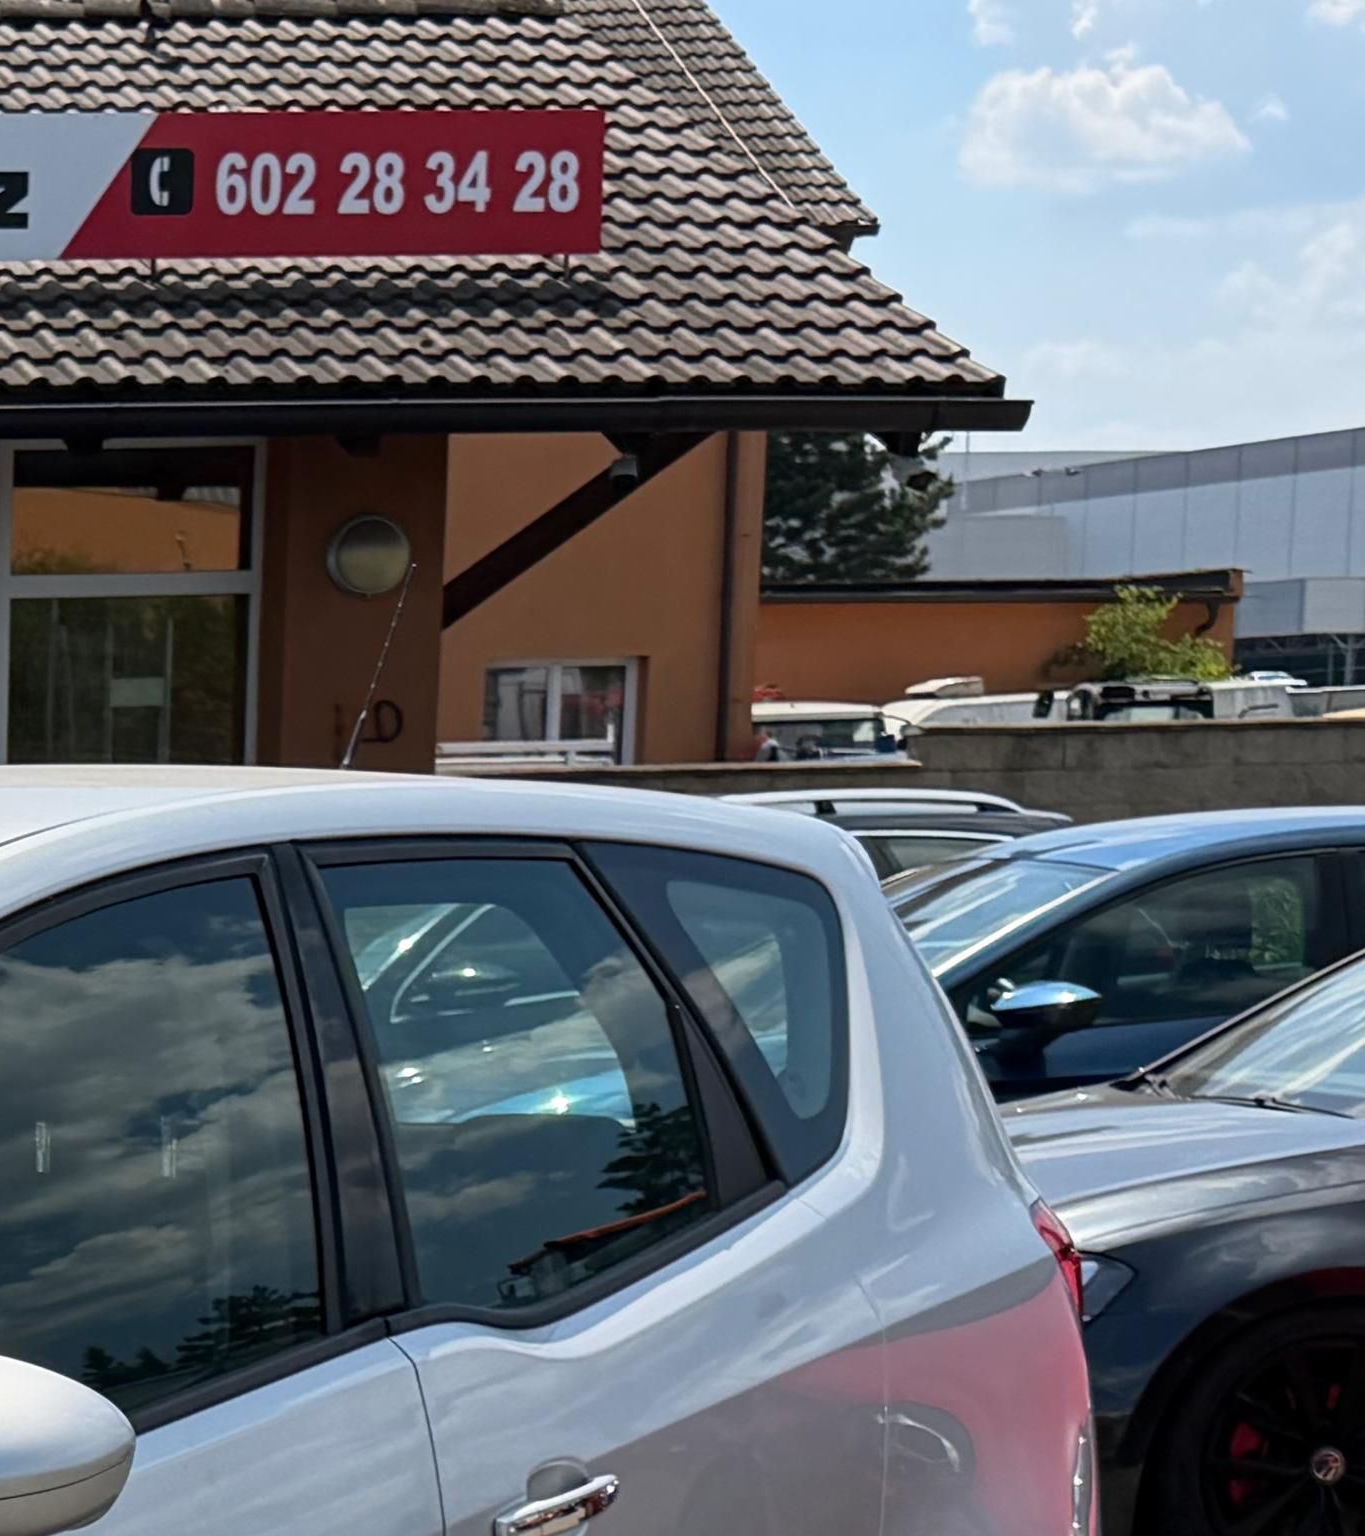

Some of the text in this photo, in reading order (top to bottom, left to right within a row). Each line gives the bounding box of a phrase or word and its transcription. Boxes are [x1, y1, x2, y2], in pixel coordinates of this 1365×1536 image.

[215, 150, 580, 215] 602 28 34 28
